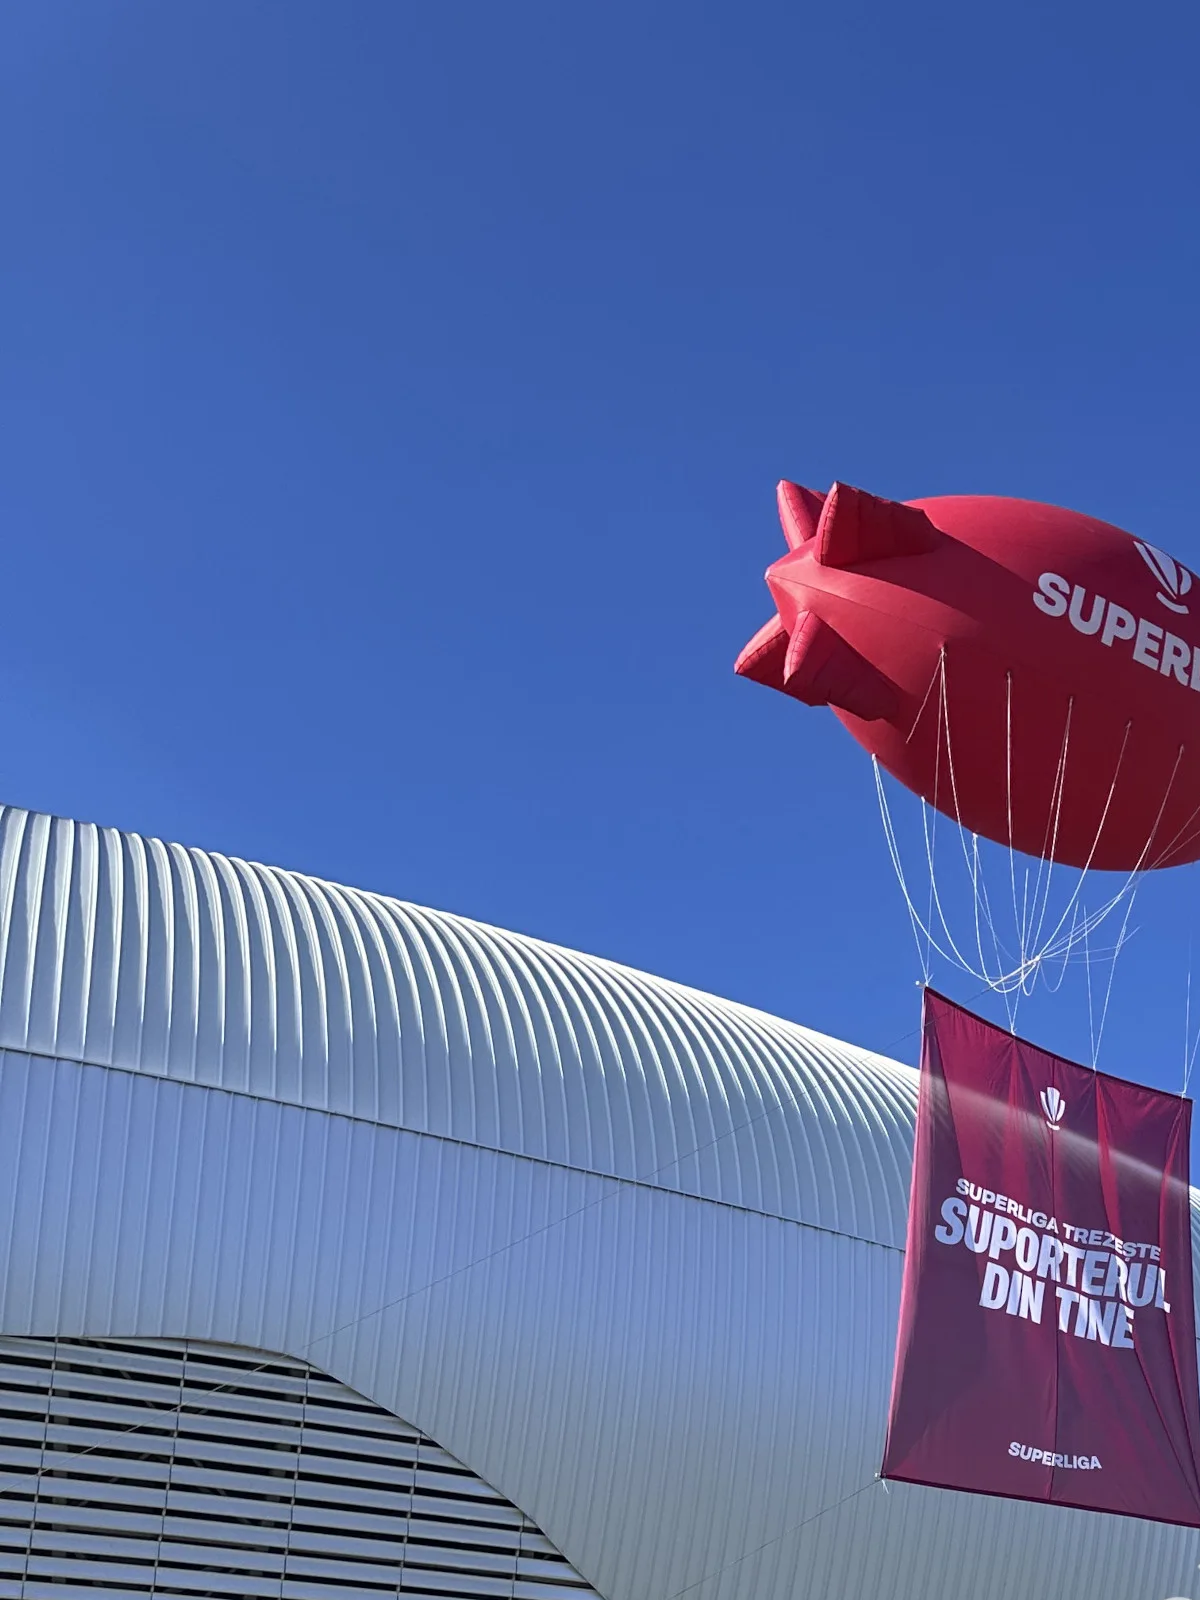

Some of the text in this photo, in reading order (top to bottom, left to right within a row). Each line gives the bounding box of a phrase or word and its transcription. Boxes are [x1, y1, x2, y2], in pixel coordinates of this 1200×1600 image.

[956, 1178, 1060, 1235] SUPERLIGA
[934, 1197, 1171, 1314] SUPORTERUL
[978, 1261, 1135, 1350] DIN TINE
[1008, 1441, 1103, 1470] SUPERLIGA
